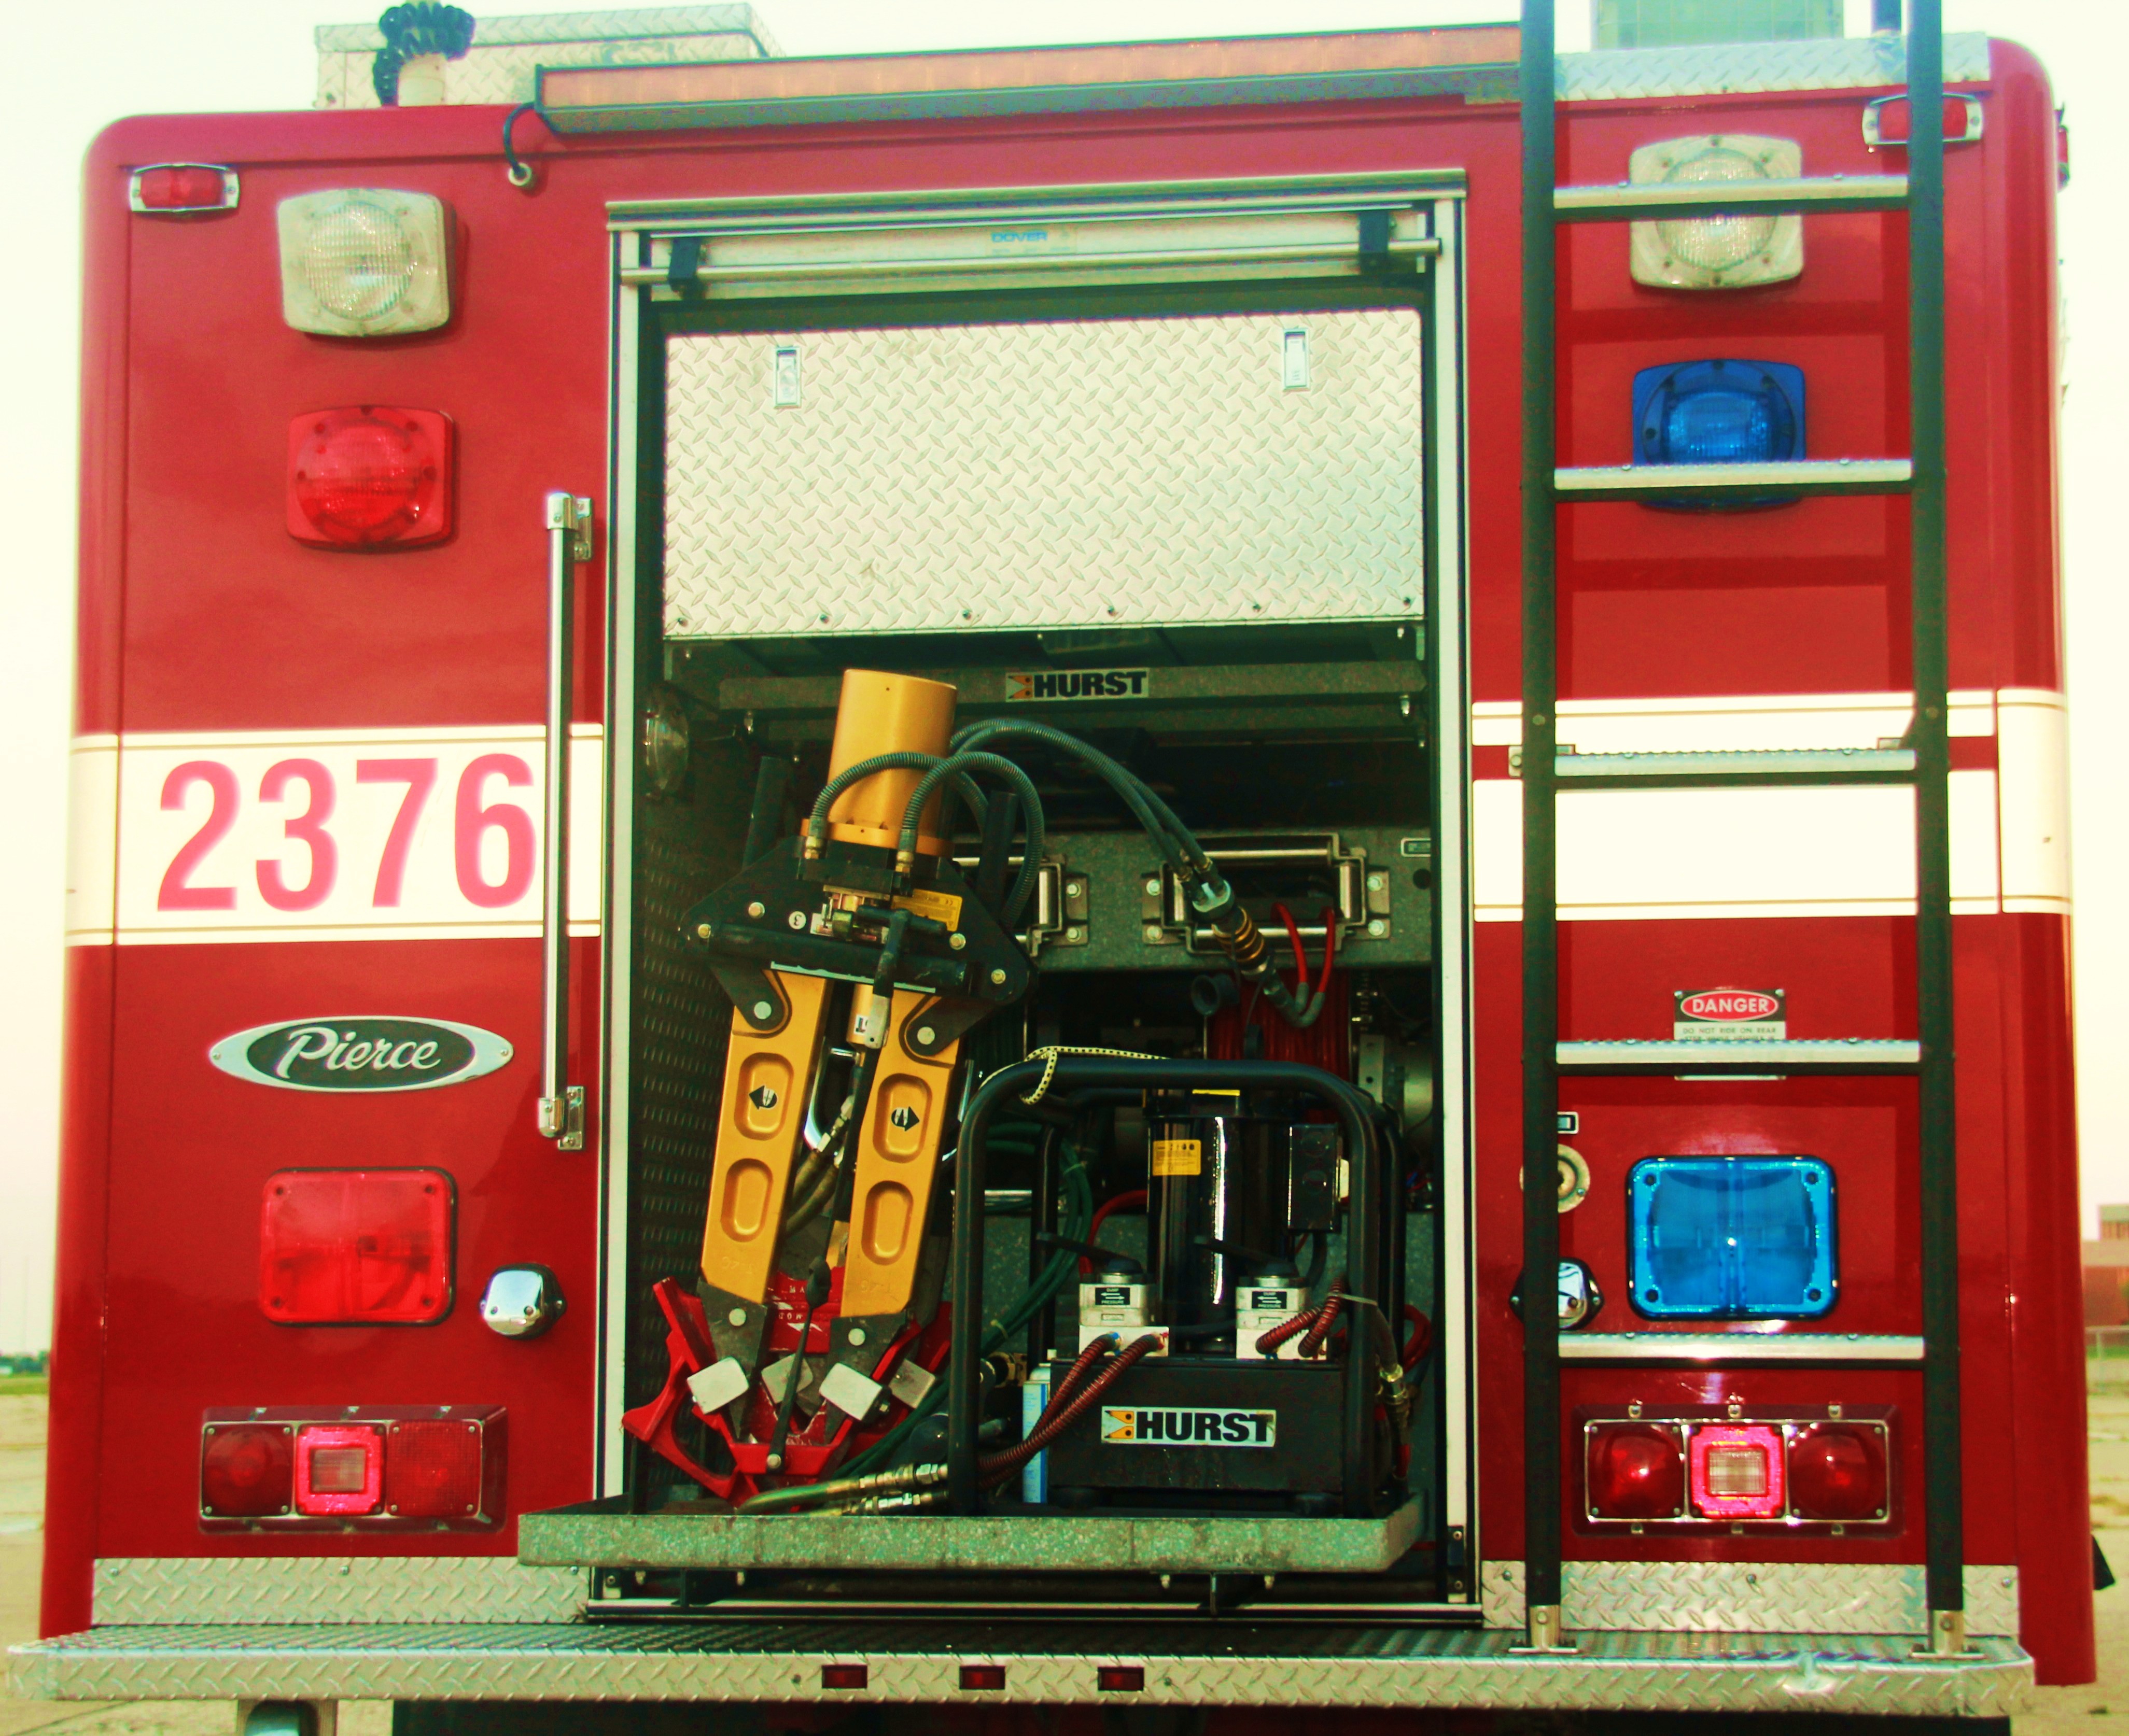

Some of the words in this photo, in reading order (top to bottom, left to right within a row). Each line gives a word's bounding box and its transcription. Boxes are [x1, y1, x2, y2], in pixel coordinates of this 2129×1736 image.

[990, 232, 1048, 243] DOVER
[1033, 671, 1147, 697] HURST
[157, 753, 537, 912] 2376
[1692, 998, 1769, 1013] DANGER
[276, 1026, 442, 1079] Pierce
[1136, 1411, 1273, 1442] HURST
